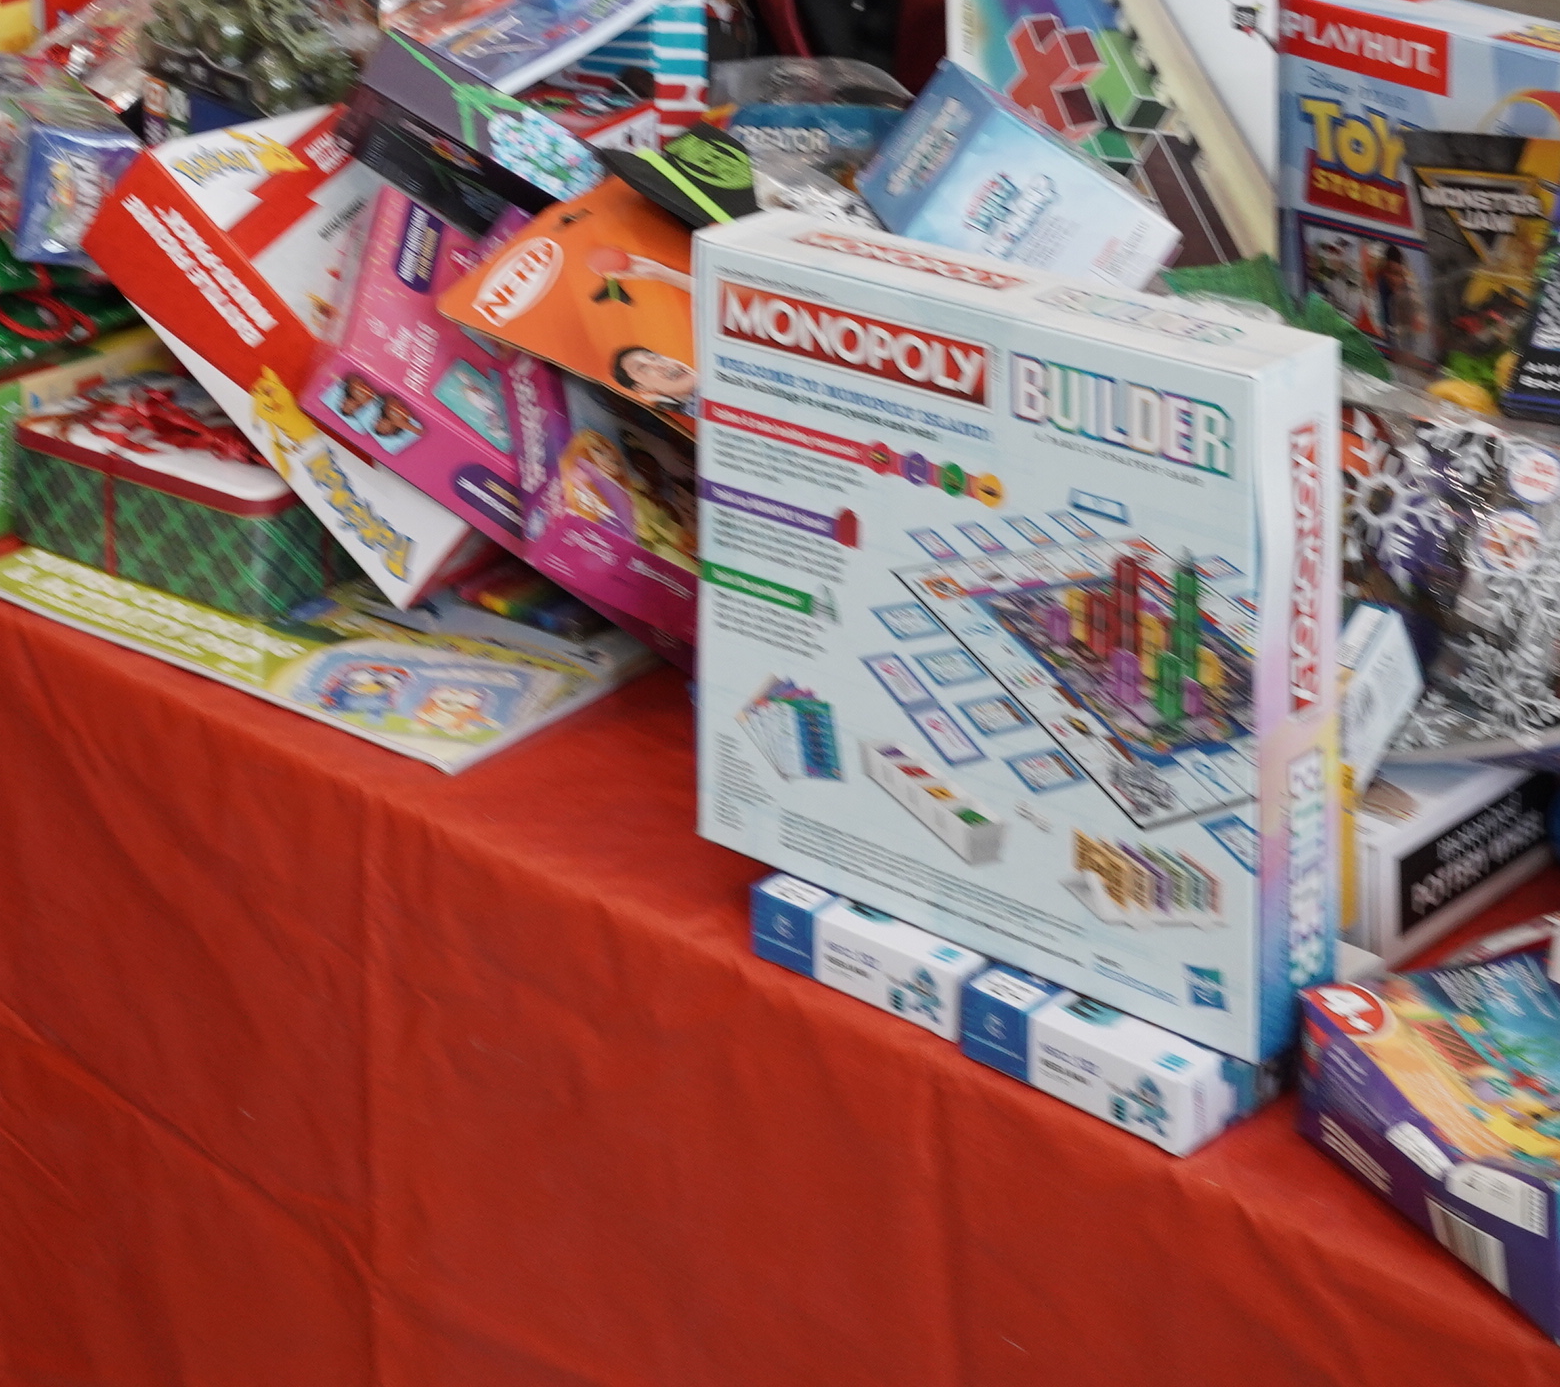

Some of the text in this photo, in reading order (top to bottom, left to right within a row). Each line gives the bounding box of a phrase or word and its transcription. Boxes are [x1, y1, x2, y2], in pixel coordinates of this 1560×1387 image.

[1281, 7, 1440, 77] PLAYHUT
[1299, 95, 1426, 187] TOY
[1311, 167, 1407, 215] STORY
[1418, 184, 1544, 218] MONSTER
[482, 240, 554, 319] NERF
[724, 285, 986, 397] MONOPOLY
[1012, 352, 1234, 479] BUILDER
